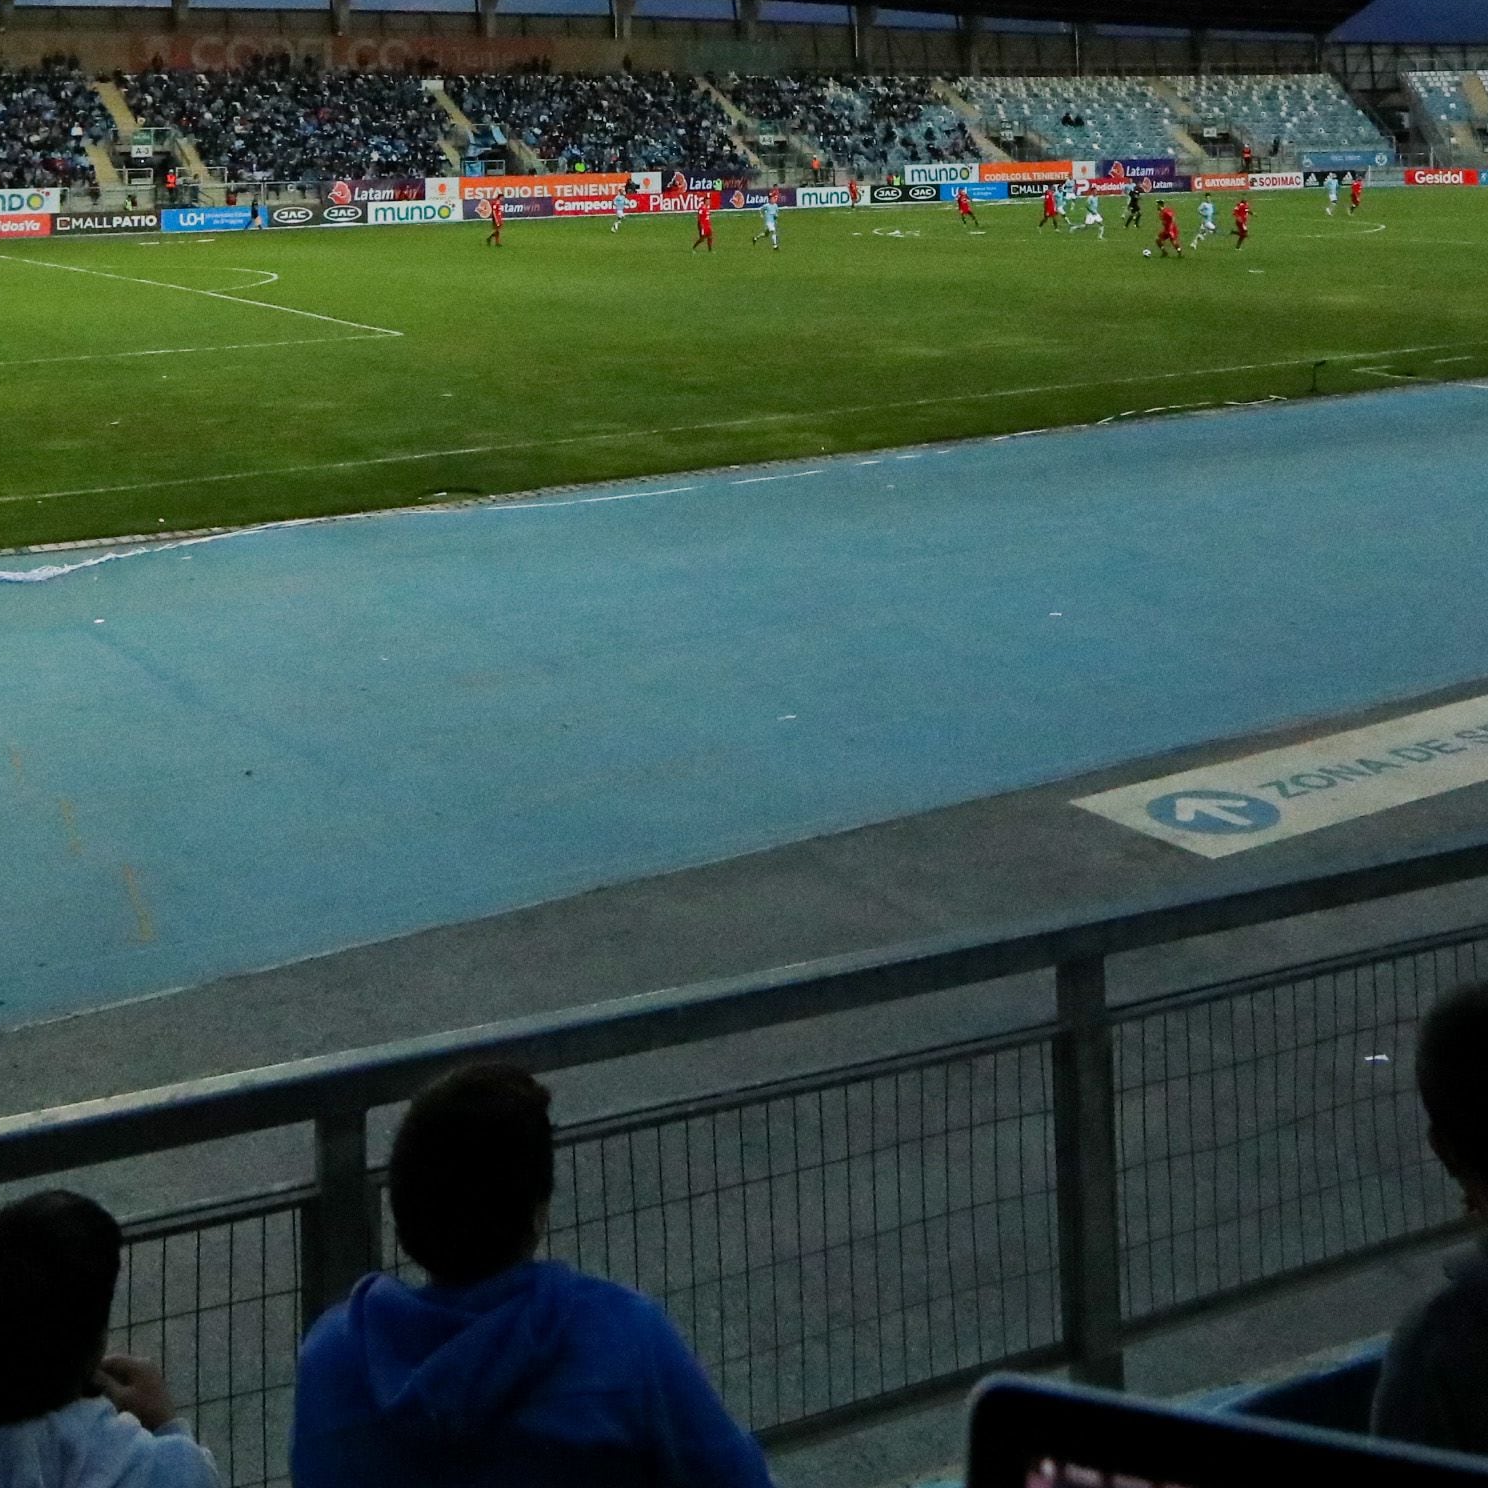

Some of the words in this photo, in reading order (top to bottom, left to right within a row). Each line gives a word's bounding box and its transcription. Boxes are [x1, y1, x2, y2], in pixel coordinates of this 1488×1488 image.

[1032, 171, 1070, 181] TENIENTE
[1205, 176, 1246, 187] GATORADE
[1259, 175, 1301, 187] SODIMAC
[1415, 170, 1464, 184] Gesidol
[464, 185, 532, 199] ESTADIO
[535, 185, 552, 198] EL
[1259, 752, 1398, 800] ZONA
[1398, 734, 1468, 764] DE
